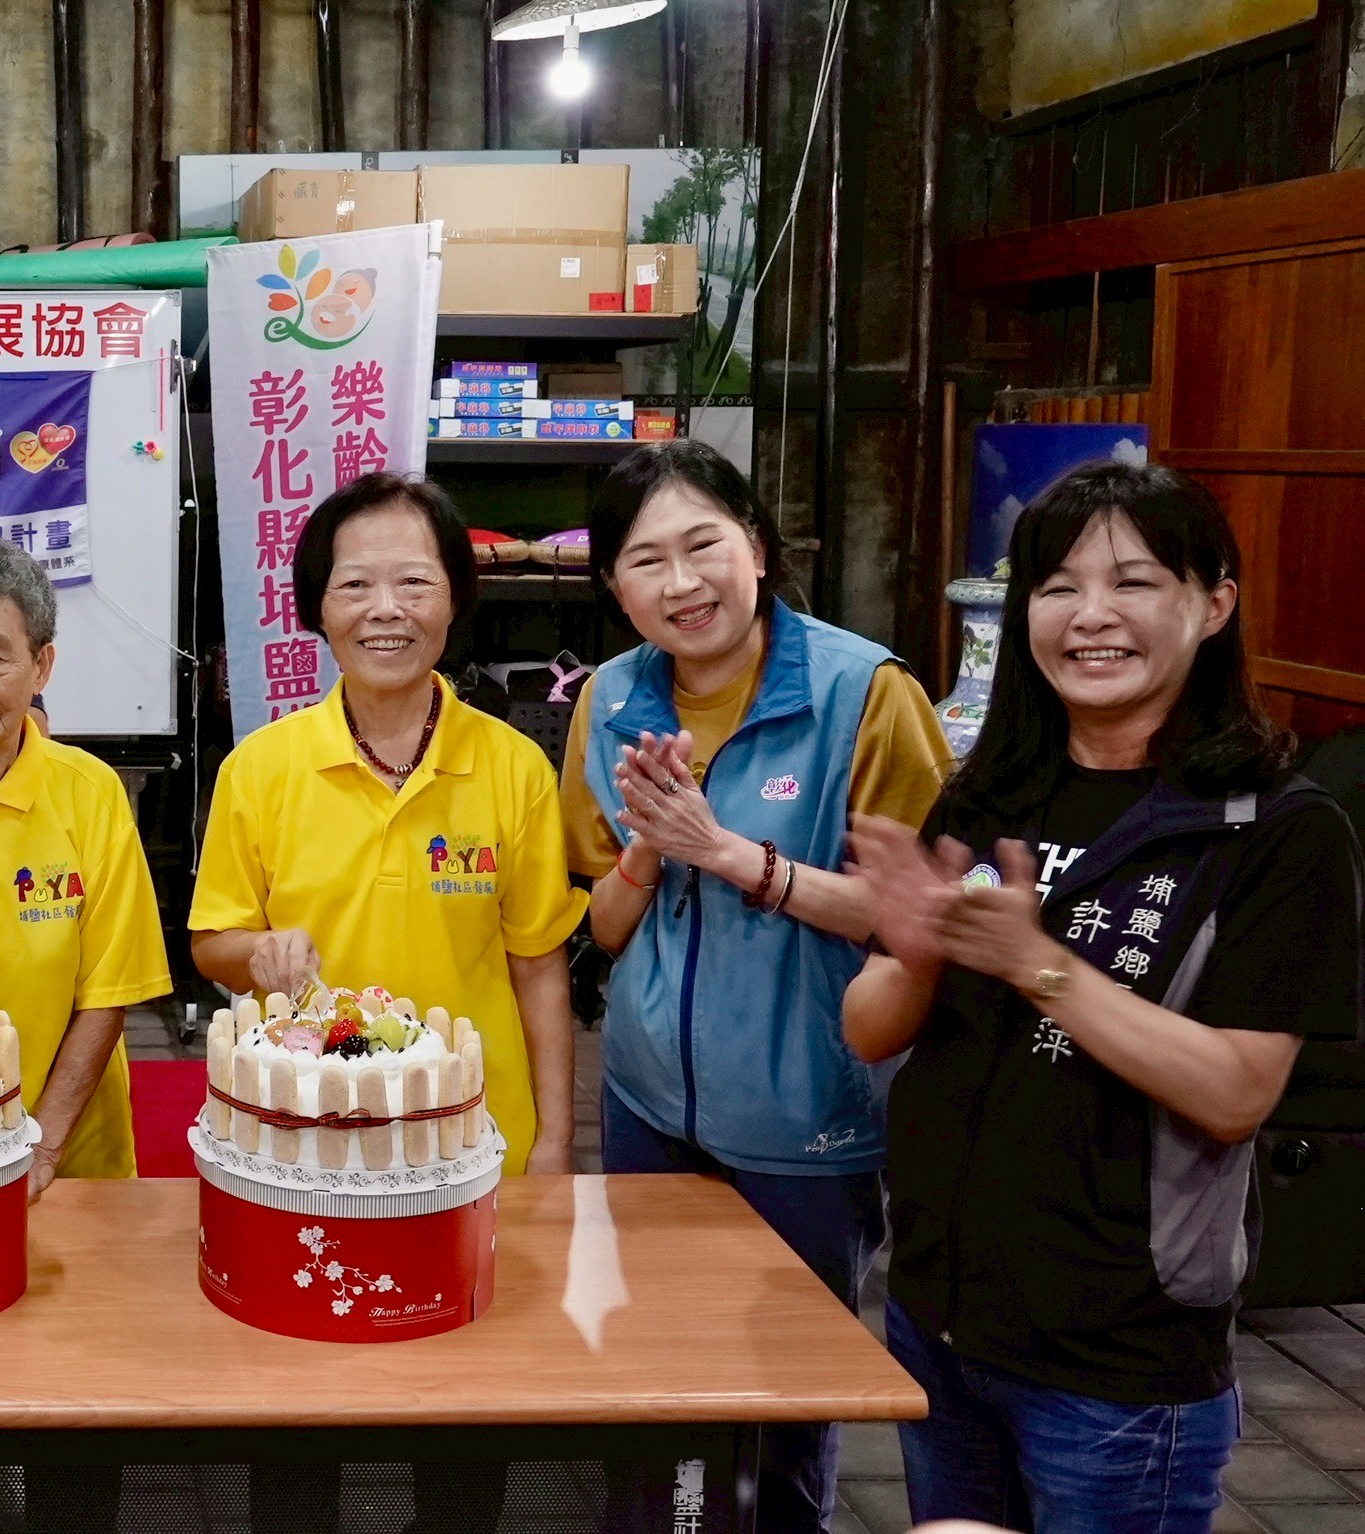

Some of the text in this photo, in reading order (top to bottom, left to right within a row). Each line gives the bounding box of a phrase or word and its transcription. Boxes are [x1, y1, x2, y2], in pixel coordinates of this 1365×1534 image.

[248, 369, 323, 721] 彰化縣埔鹽
[1111, 874, 1177, 989] 埔鹽鄉
[369, 1307, 401, 1317] Happy
[403, 1302, 441, 1314] Birthday
